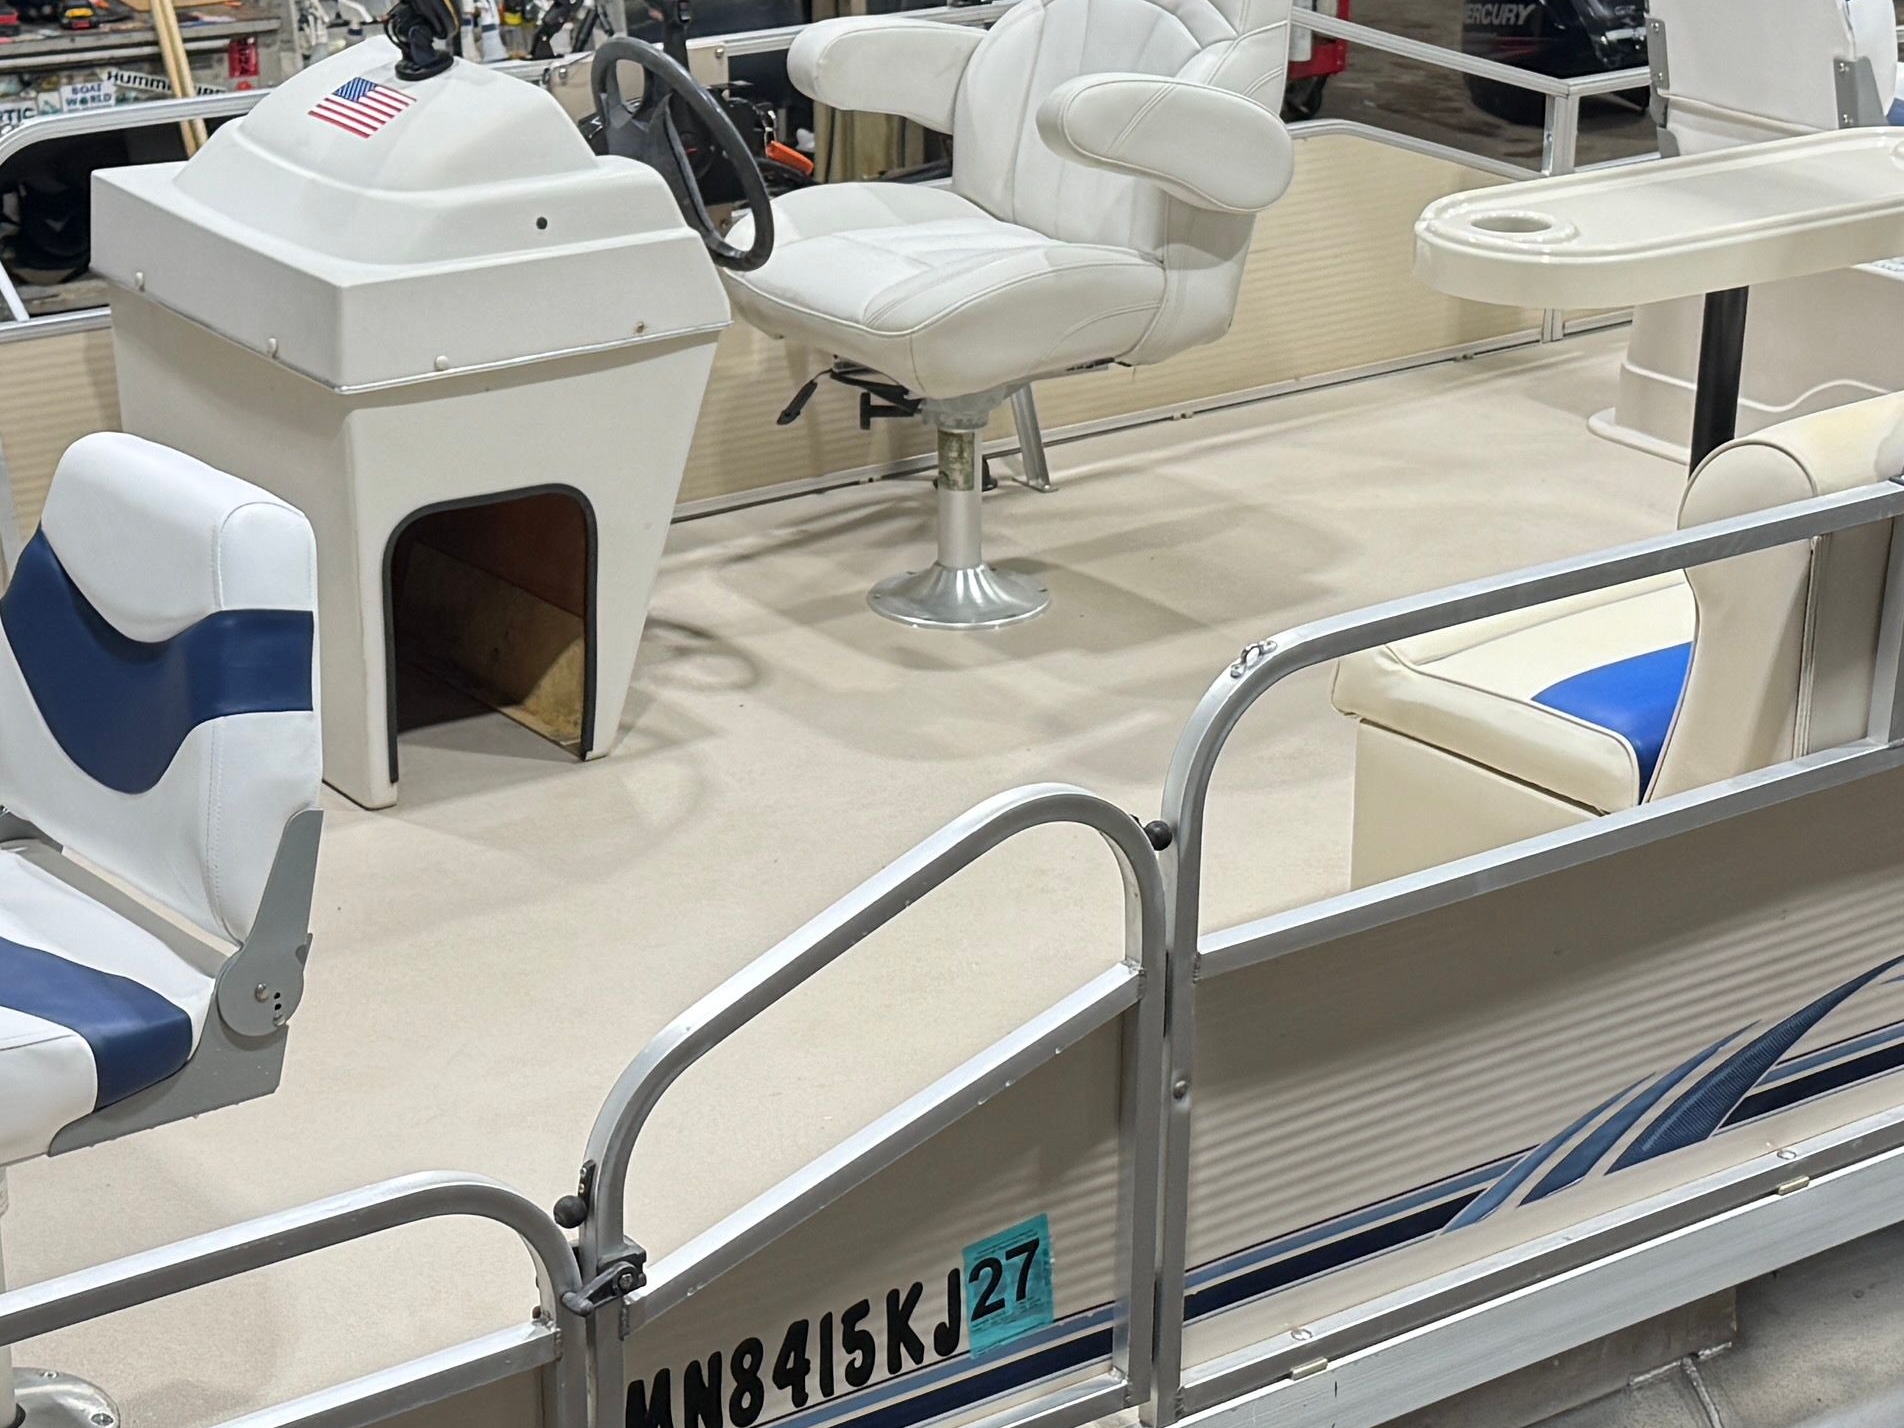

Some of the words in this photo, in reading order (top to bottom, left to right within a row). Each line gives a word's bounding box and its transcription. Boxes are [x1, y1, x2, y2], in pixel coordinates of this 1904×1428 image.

[71, 83, 102, 95] BOAT
[66, 93, 112, 106] WORLD
[968, 1237, 1040, 1322] 27
